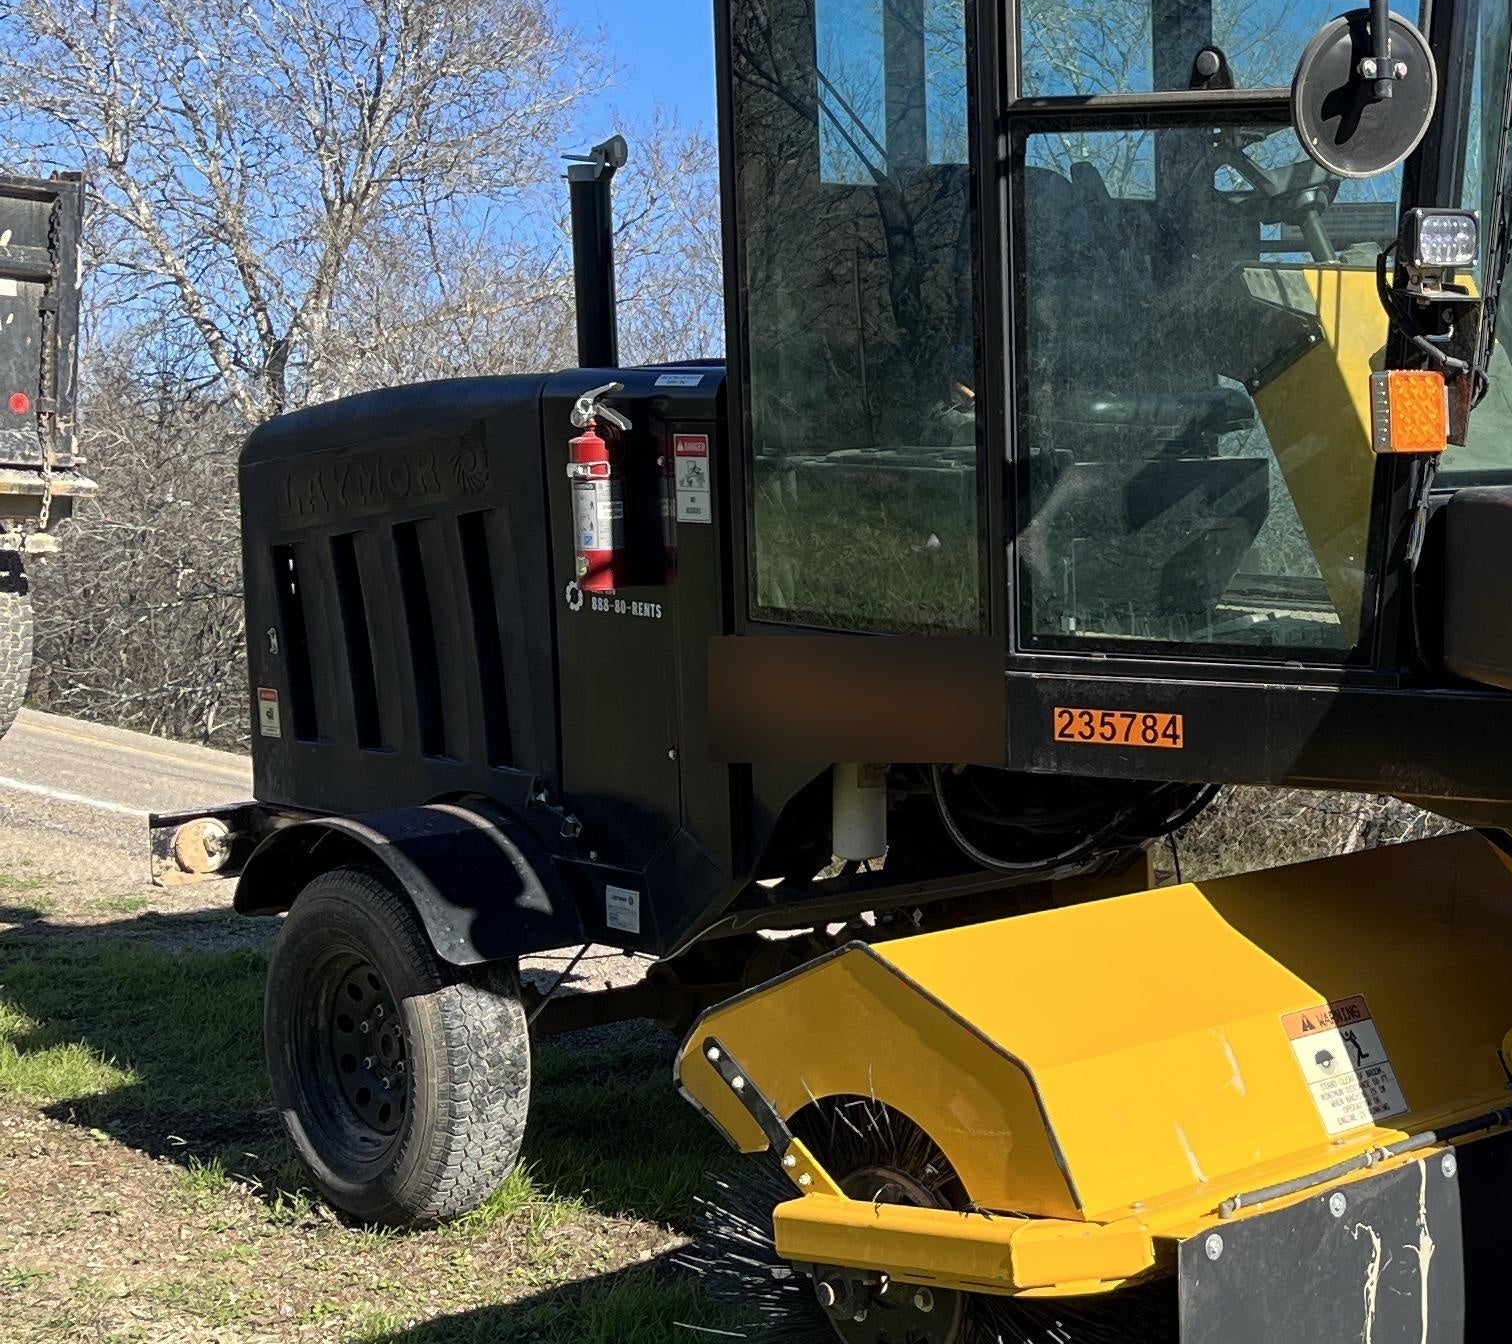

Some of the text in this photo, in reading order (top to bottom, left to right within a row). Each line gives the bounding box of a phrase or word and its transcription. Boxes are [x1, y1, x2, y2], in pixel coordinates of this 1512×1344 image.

[591, 596, 663, 619] 888-80-RENTS
[1056, 708, 1181, 746] 235784
[1316, 1003, 1361, 1028] WARNING
